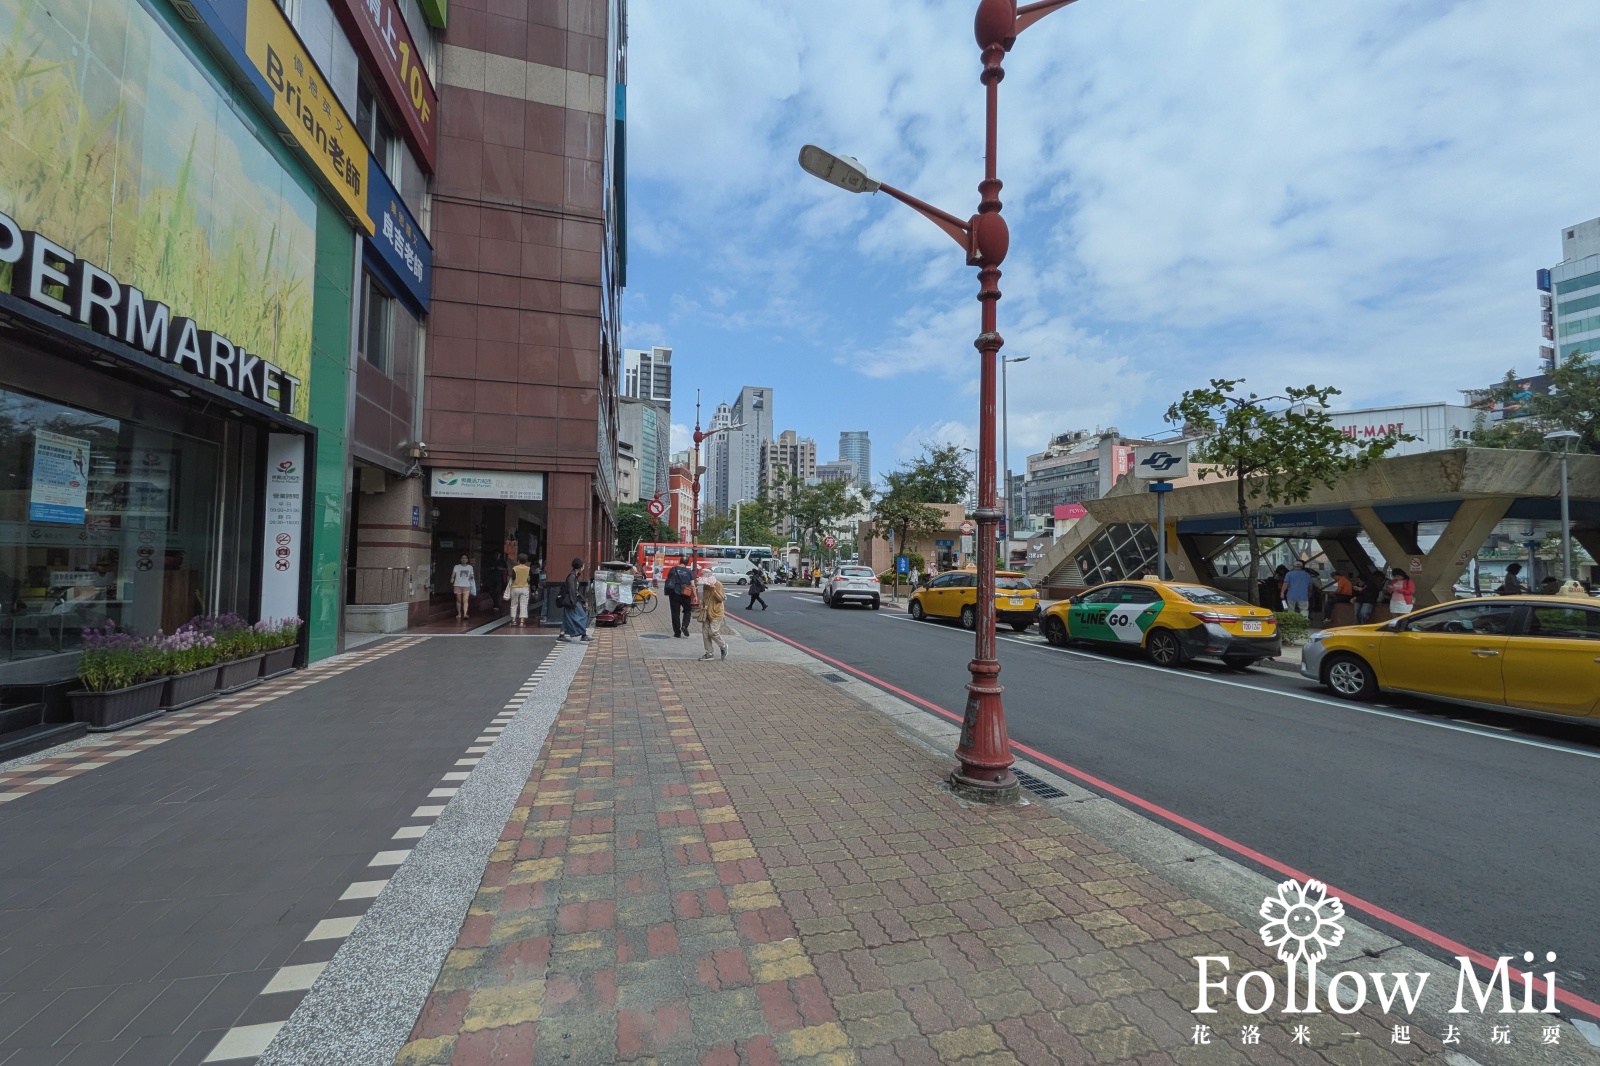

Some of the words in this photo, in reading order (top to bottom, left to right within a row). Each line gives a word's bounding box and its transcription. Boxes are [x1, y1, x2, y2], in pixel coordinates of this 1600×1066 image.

[266, 42, 360, 197] Brian老師
[382, 211, 424, 283] 良吉老師
[1080, 612, 1106, 625] LINE
[1109, 614, 1128, 626] GO
